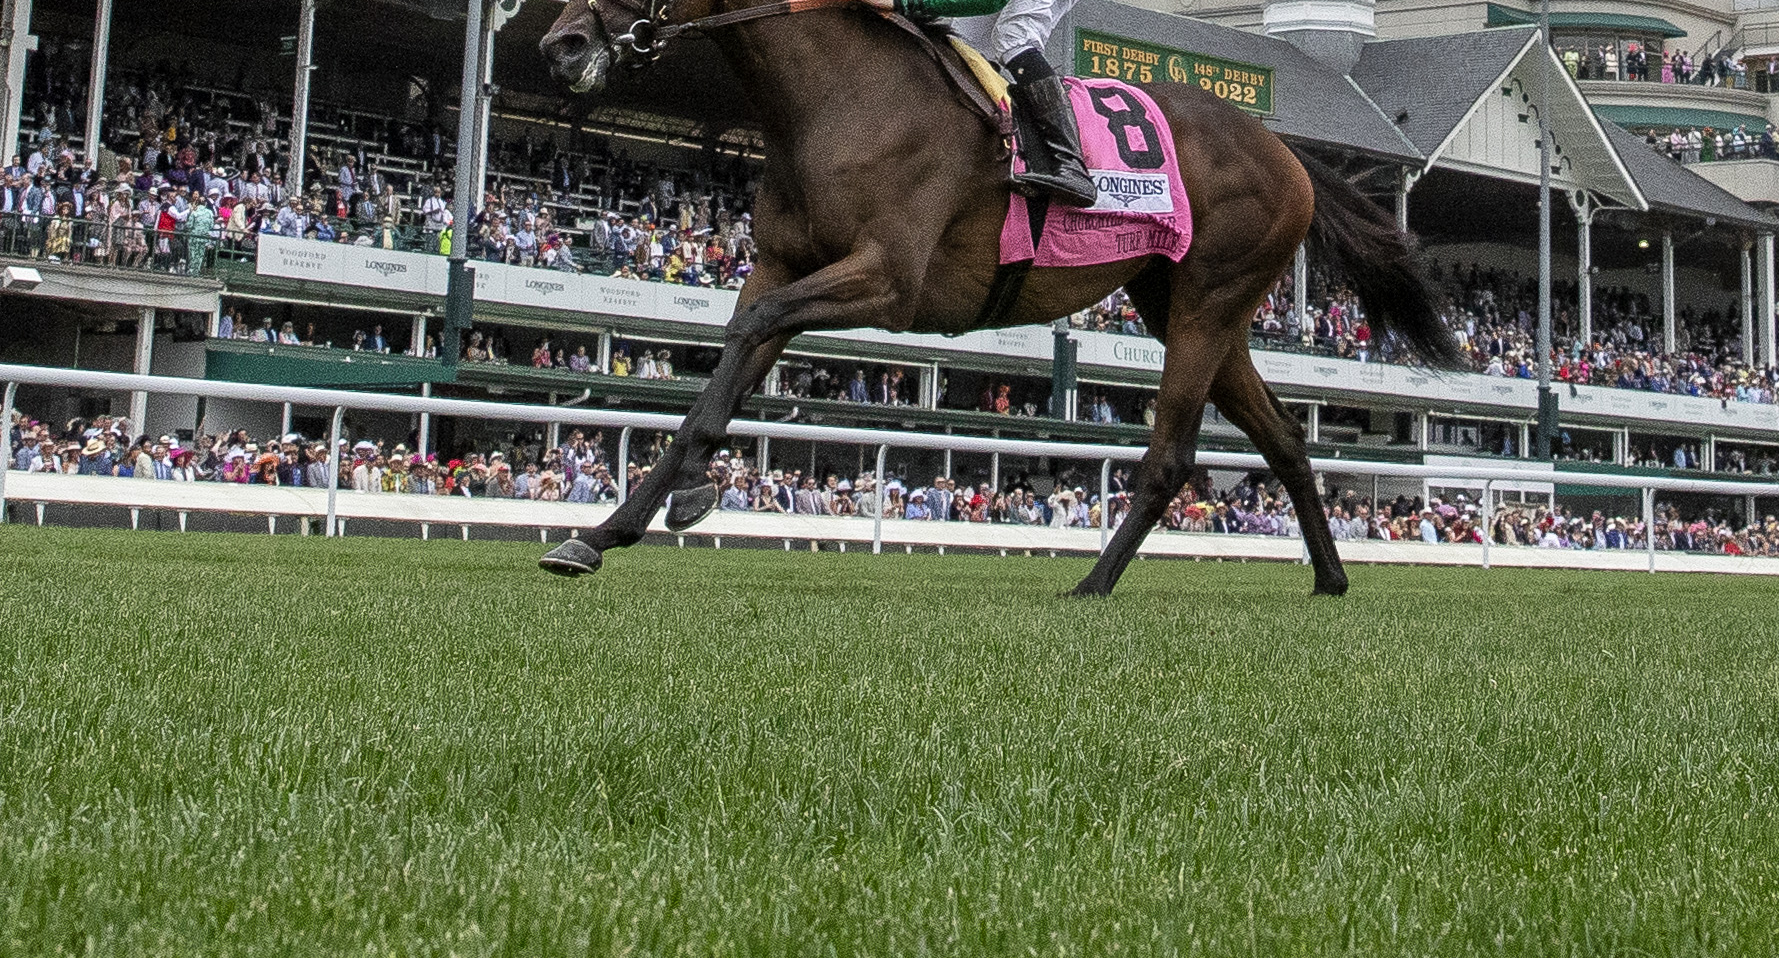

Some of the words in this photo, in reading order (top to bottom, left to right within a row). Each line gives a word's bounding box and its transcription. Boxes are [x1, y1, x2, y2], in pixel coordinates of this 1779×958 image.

[1083, 39, 1118, 56] FIRST
[1122, 47, 1160, 66] DERBY
[1091, 55, 1153, 83] 1875
[1224, 67, 1265, 86] DERBY
[1199, 77, 1257, 104] 2022
[1086, 86, 1166, 169] 8
[1115, 231, 1142, 253] TURF
[365, 259, 407, 273] LONGINES
